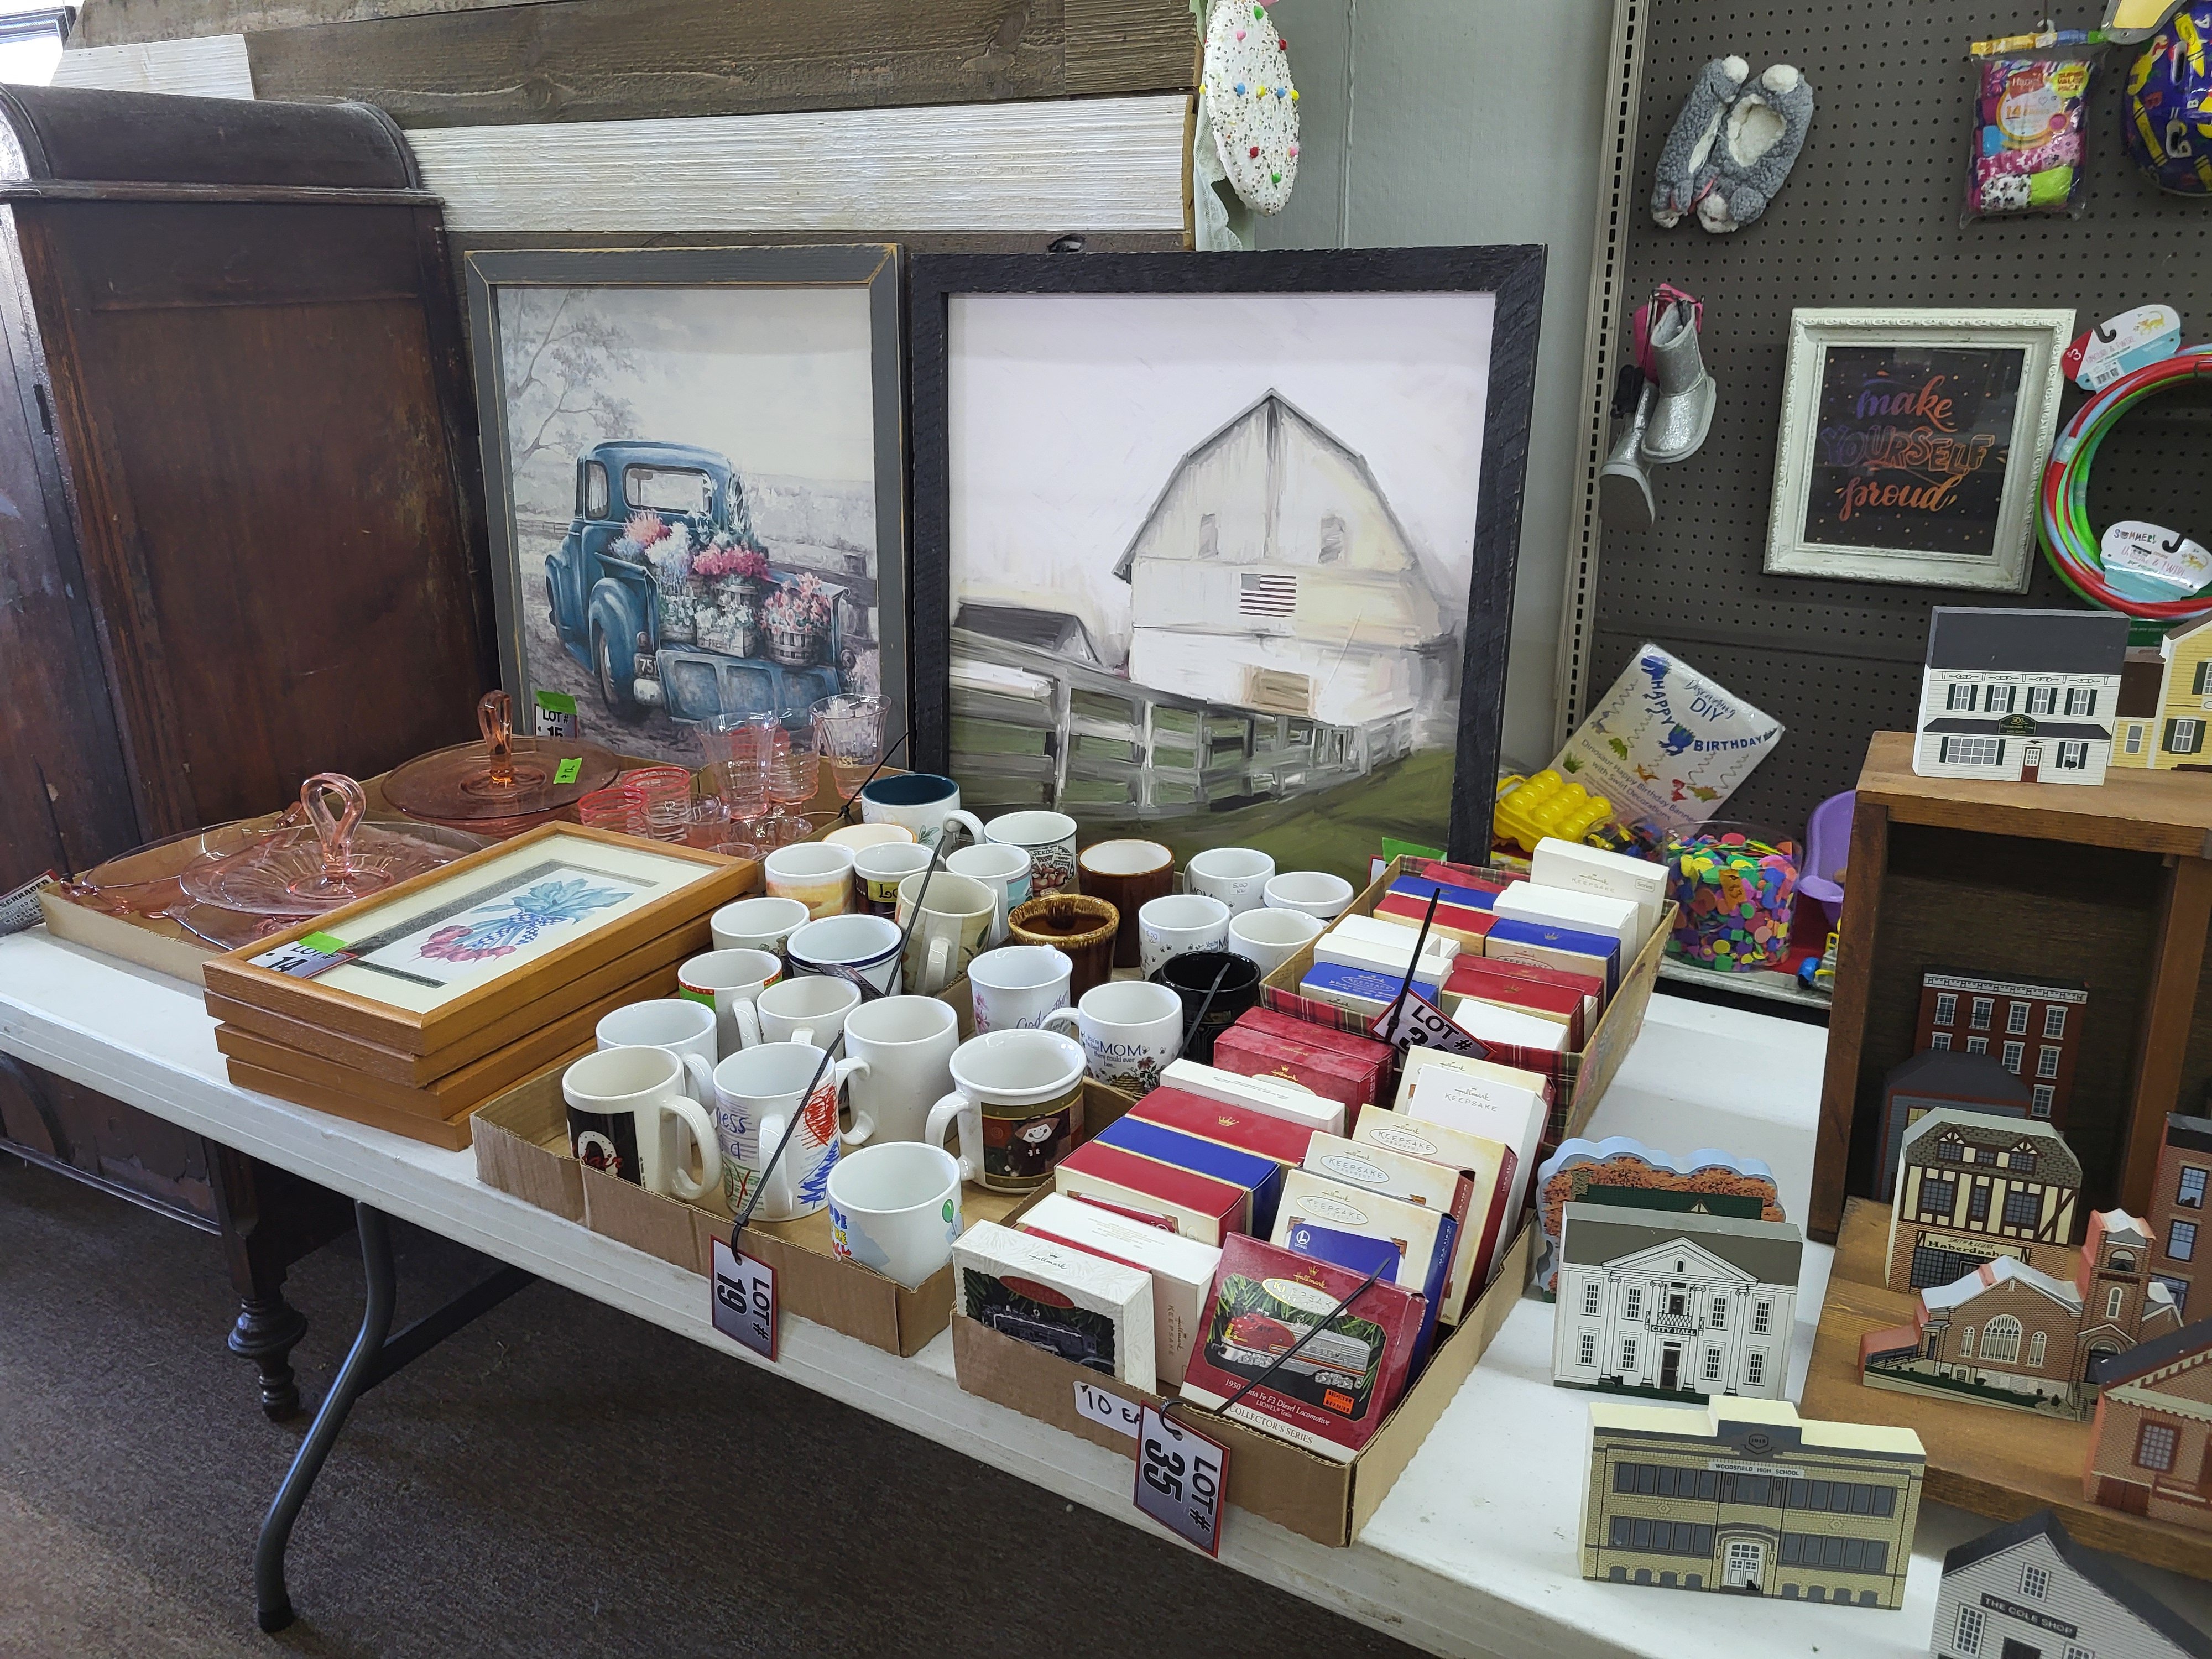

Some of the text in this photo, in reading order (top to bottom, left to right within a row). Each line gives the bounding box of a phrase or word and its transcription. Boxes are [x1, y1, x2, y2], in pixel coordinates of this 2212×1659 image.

[2067, 349, 2082, 361] $3
[1856, 375, 1958, 432] make
[1821, 425, 1995, 476] YOURSELF
[1839, 475, 1963, 521] proud
[1642, 680, 1676, 725] HAPPY
[1689, 697, 1724, 722] DIY
[543, 709, 562, 723] LOT
[1694, 735, 1762, 752] BIRTHDAY
[1581, 739, 1614, 768] Dinosaur
[1614, 764, 1638, 786] Happy
[1637, 782, 1670, 808] Birthday
[1592, 761, 1609, 776] with
[1608, 773, 1627, 791] Swirl
[1626, 787, 1672, 821] Decorations
[1572, 878, 1615, 893] KEEPSAKE
[266, 956, 310, 972] 14
[1411, 1004, 1474, 1051] LOT #
[1094, 1051, 1105, 1059] there
[1100, 1041, 1142, 1056] MOM
[1271, 1069, 1299, 1082] Hallmark
[1438, 1061, 1466, 1072] Hallmark
[1444, 1093, 1498, 1112] KEEPSAKE
[1454, 1087, 1491, 1102] Hallmark
[1392, 1123, 1420, 1135] Hallmark
[1378, 1130, 1432, 1151] KEEPSAKE
[1343, 1150, 1371, 1162] Hallmark
[1329, 1157, 1384, 1179] KEEPSAKE
[1321, 1191, 1351, 1203] Hallmark
[1306, 1198, 1362, 1220] KEEPSAKE
[1029, 1253, 1068, 1270] Hallmark
[1293, 1271, 1327, 1289] Hallmark
[717, 1272, 747, 1315] 19
[753, 1276, 770, 1341] LOT #
[1175, 1316, 1185, 1352] Hallmark
[1225, 1379, 1331, 1426] 1950 nta Fe F3 Diesel Locomotive
[1280, 1409, 1292, 1418] Train
[1229, 1405, 1313, 1444] COLLECTOR'S SERIES
[1142, 1438, 1186, 1503] 35
[1715, 1464, 1753, 1472] WOODSFIELD
[1189, 1454, 1218, 1533] LOT #
[1985, 1597, 2073, 1633] THE COLE SHOP
